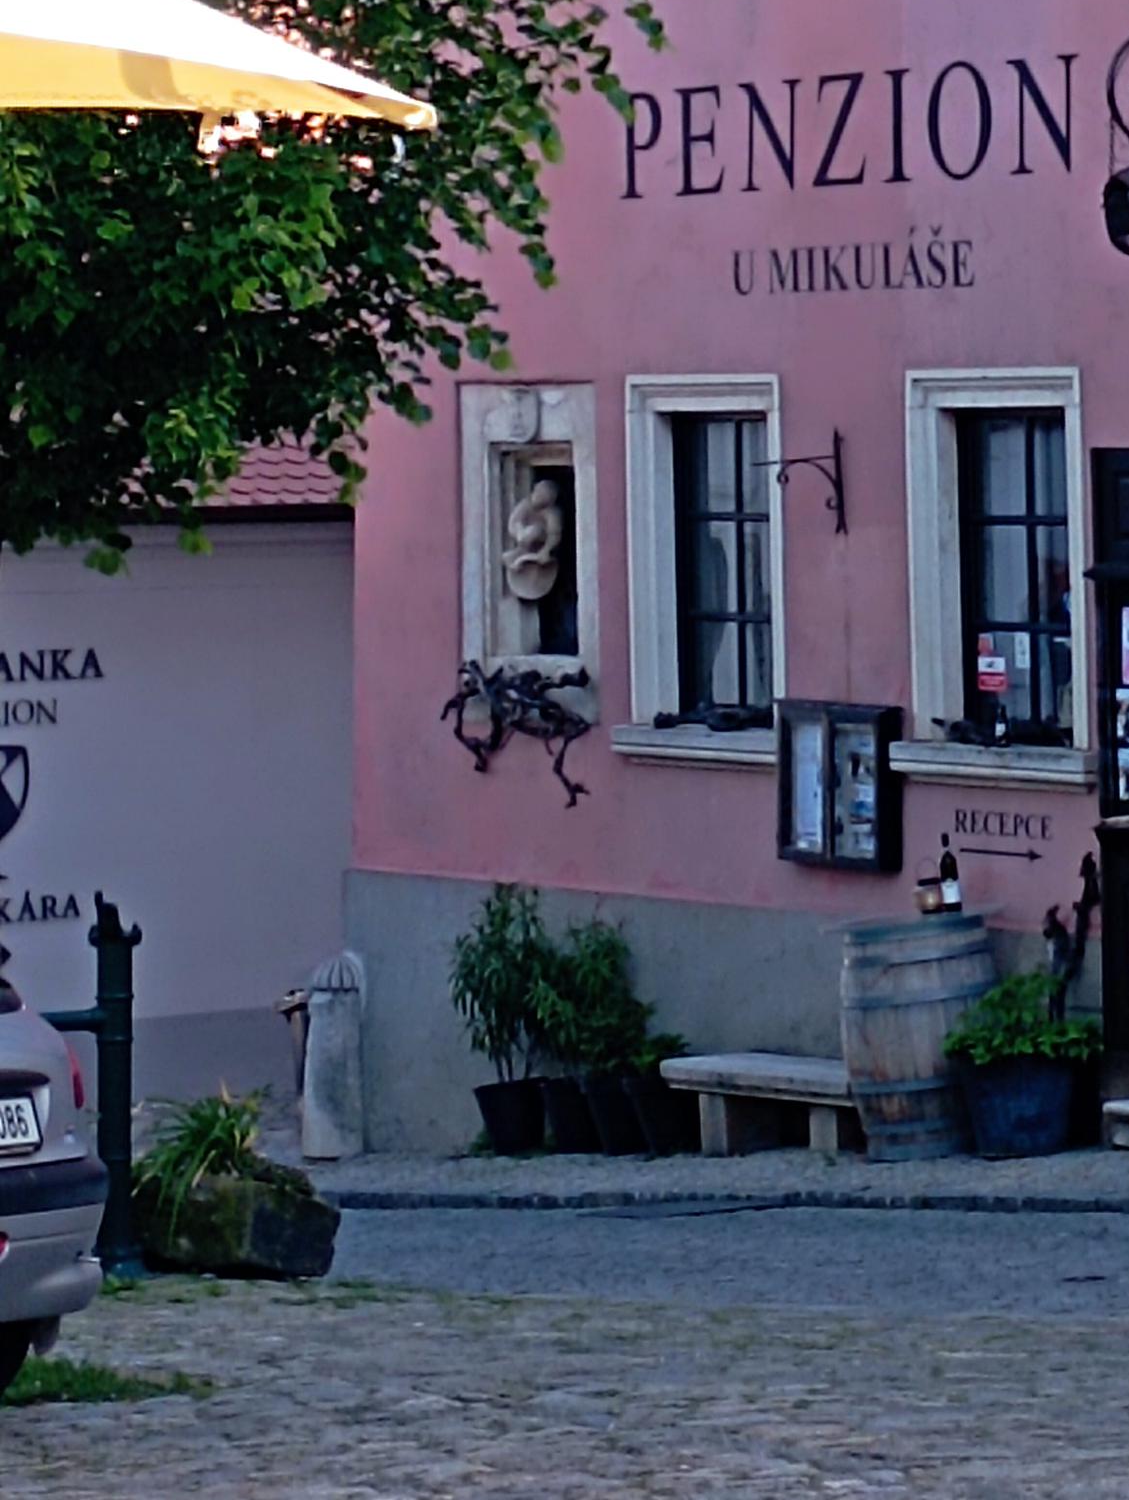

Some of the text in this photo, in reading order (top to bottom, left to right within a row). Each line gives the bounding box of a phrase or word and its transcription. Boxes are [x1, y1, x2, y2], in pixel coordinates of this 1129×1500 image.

[619, 53, 1079, 199] PENZION
[733, 225, 976, 296] U MIKULÁŠE
[0, 698, 58, 727] ION
[954, 808, 1054, 840] RECEPCE
